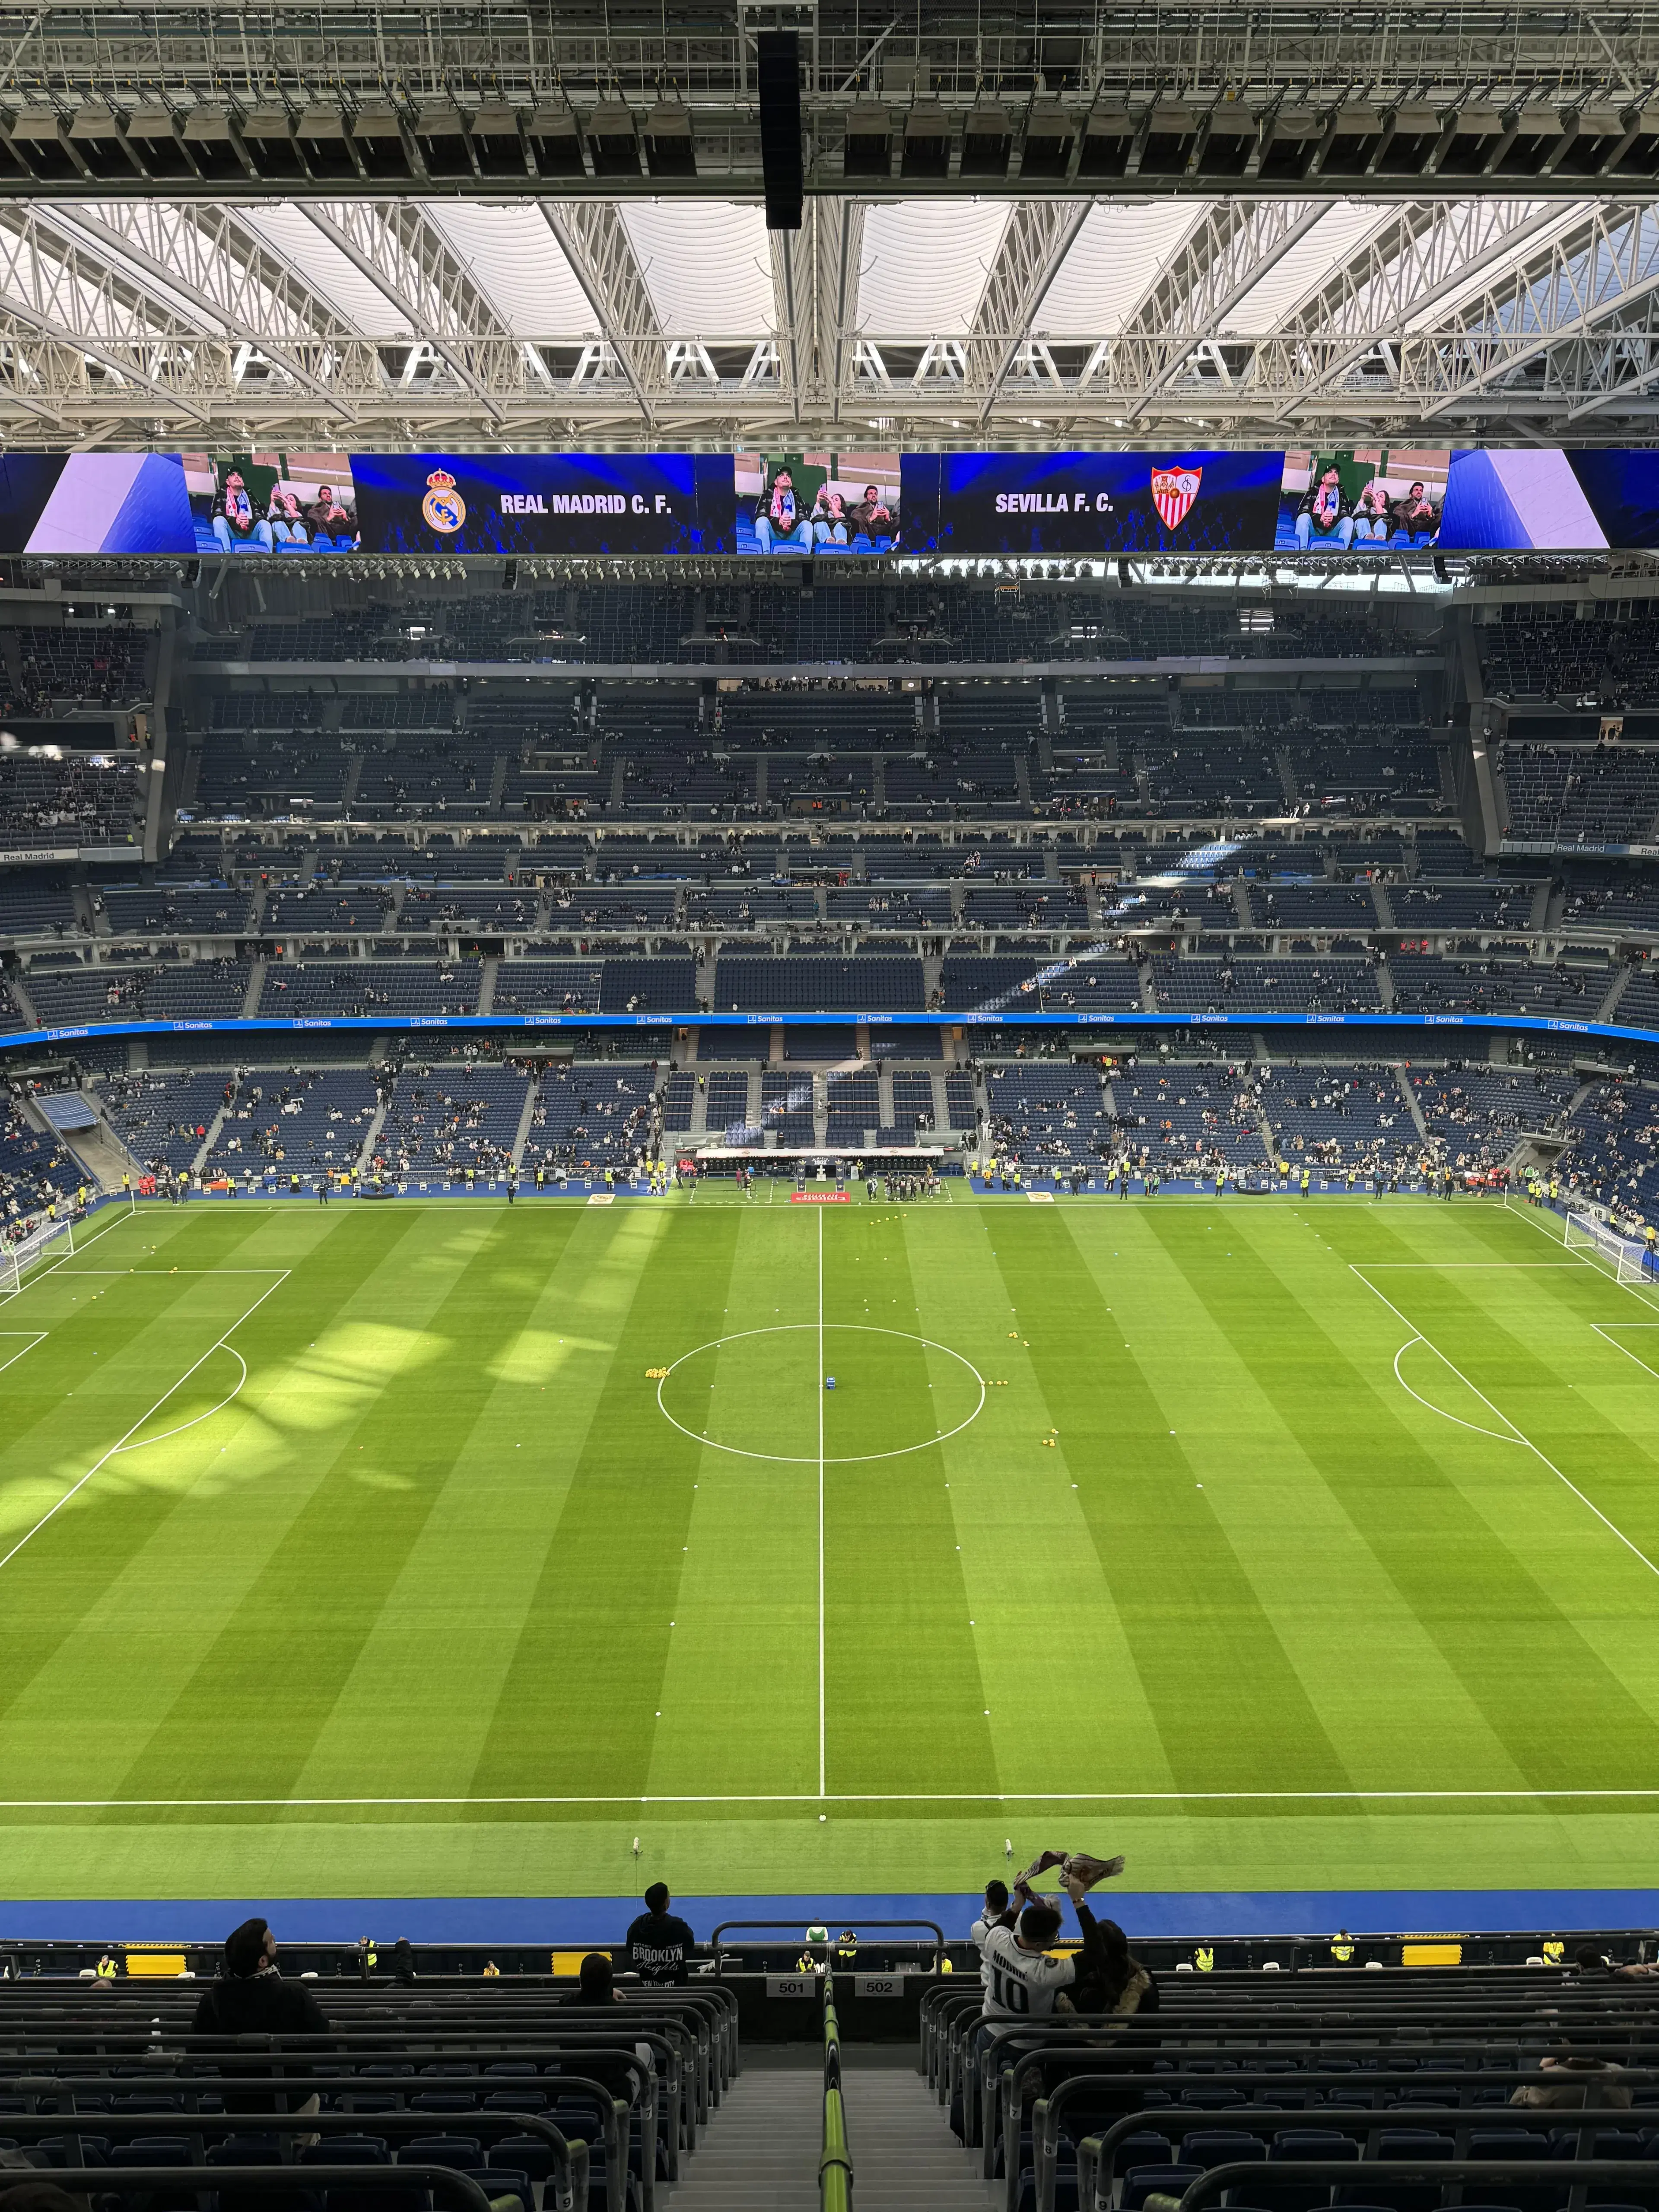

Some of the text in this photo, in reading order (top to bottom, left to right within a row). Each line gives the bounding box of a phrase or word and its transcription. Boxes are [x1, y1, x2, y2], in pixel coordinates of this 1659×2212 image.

[501, 495, 671, 513] REAL MADRID C. F.
[995, 493, 1113, 512] SEVILLA F. C.
[1559, 1022, 1588, 1031] Sanitas
[59, 1029, 89, 1037] Sanitas
[633, 1946, 683, 1962] BROOKLYN
[636, 1959, 680, 1976] Heights
[779, 1983, 803, 1993] 501
[866, 1982, 893, 1992] 502
[992, 1965, 1030, 2014] 10
[645, 2109, 651, 2117] 7
[1045, 2145, 1052, 2154] 8
[563, 2197, 571, 2208] 9
[1099, 2200, 1107, 2210] 9
